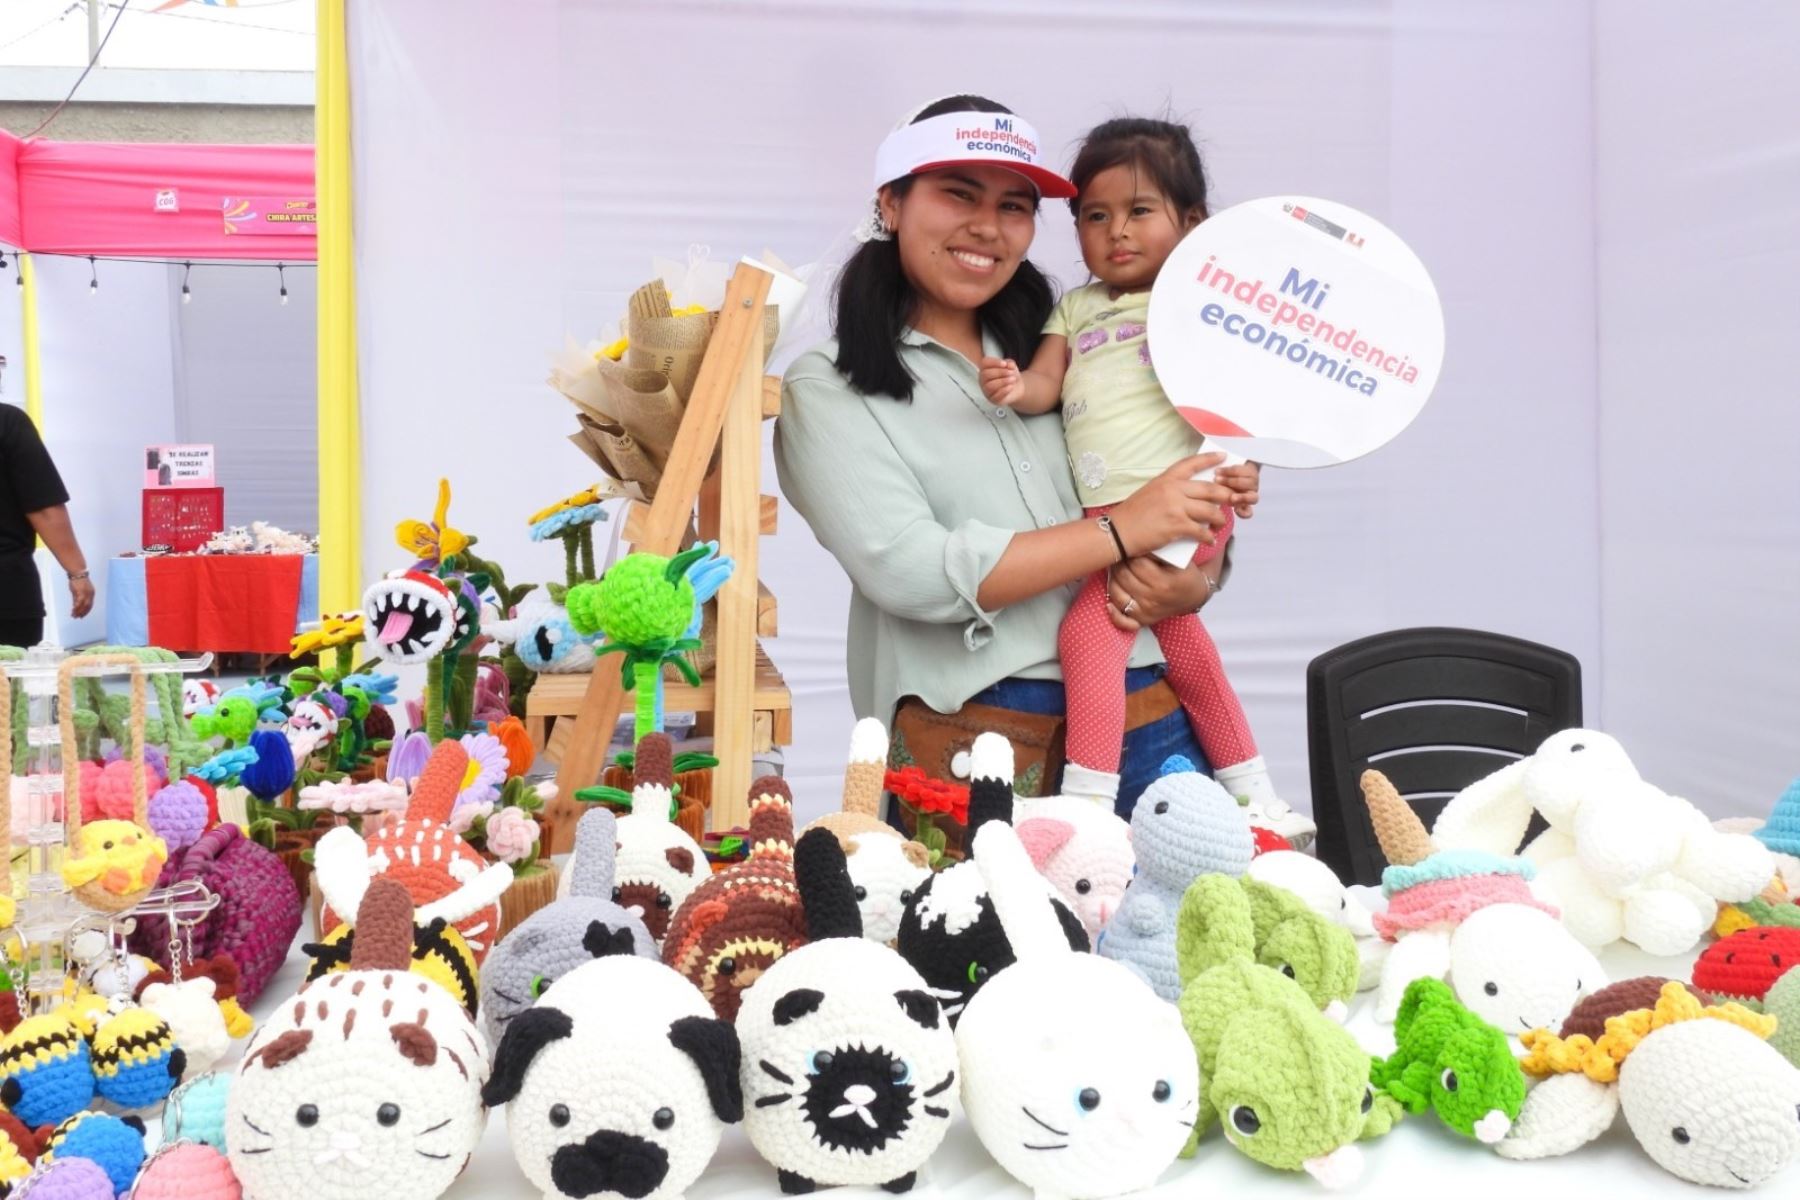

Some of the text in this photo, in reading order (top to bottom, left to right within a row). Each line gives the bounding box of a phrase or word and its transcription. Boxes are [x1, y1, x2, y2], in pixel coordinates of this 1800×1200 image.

[956, 128, 1037, 155] independencia
[995, 118, 1013, 132] Mi
[967, 140, 1031, 162] económica
[1279, 267, 1331, 310] Mi
[1197, 255, 1419, 384] independencia
[1200, 302, 1378, 397] económica
